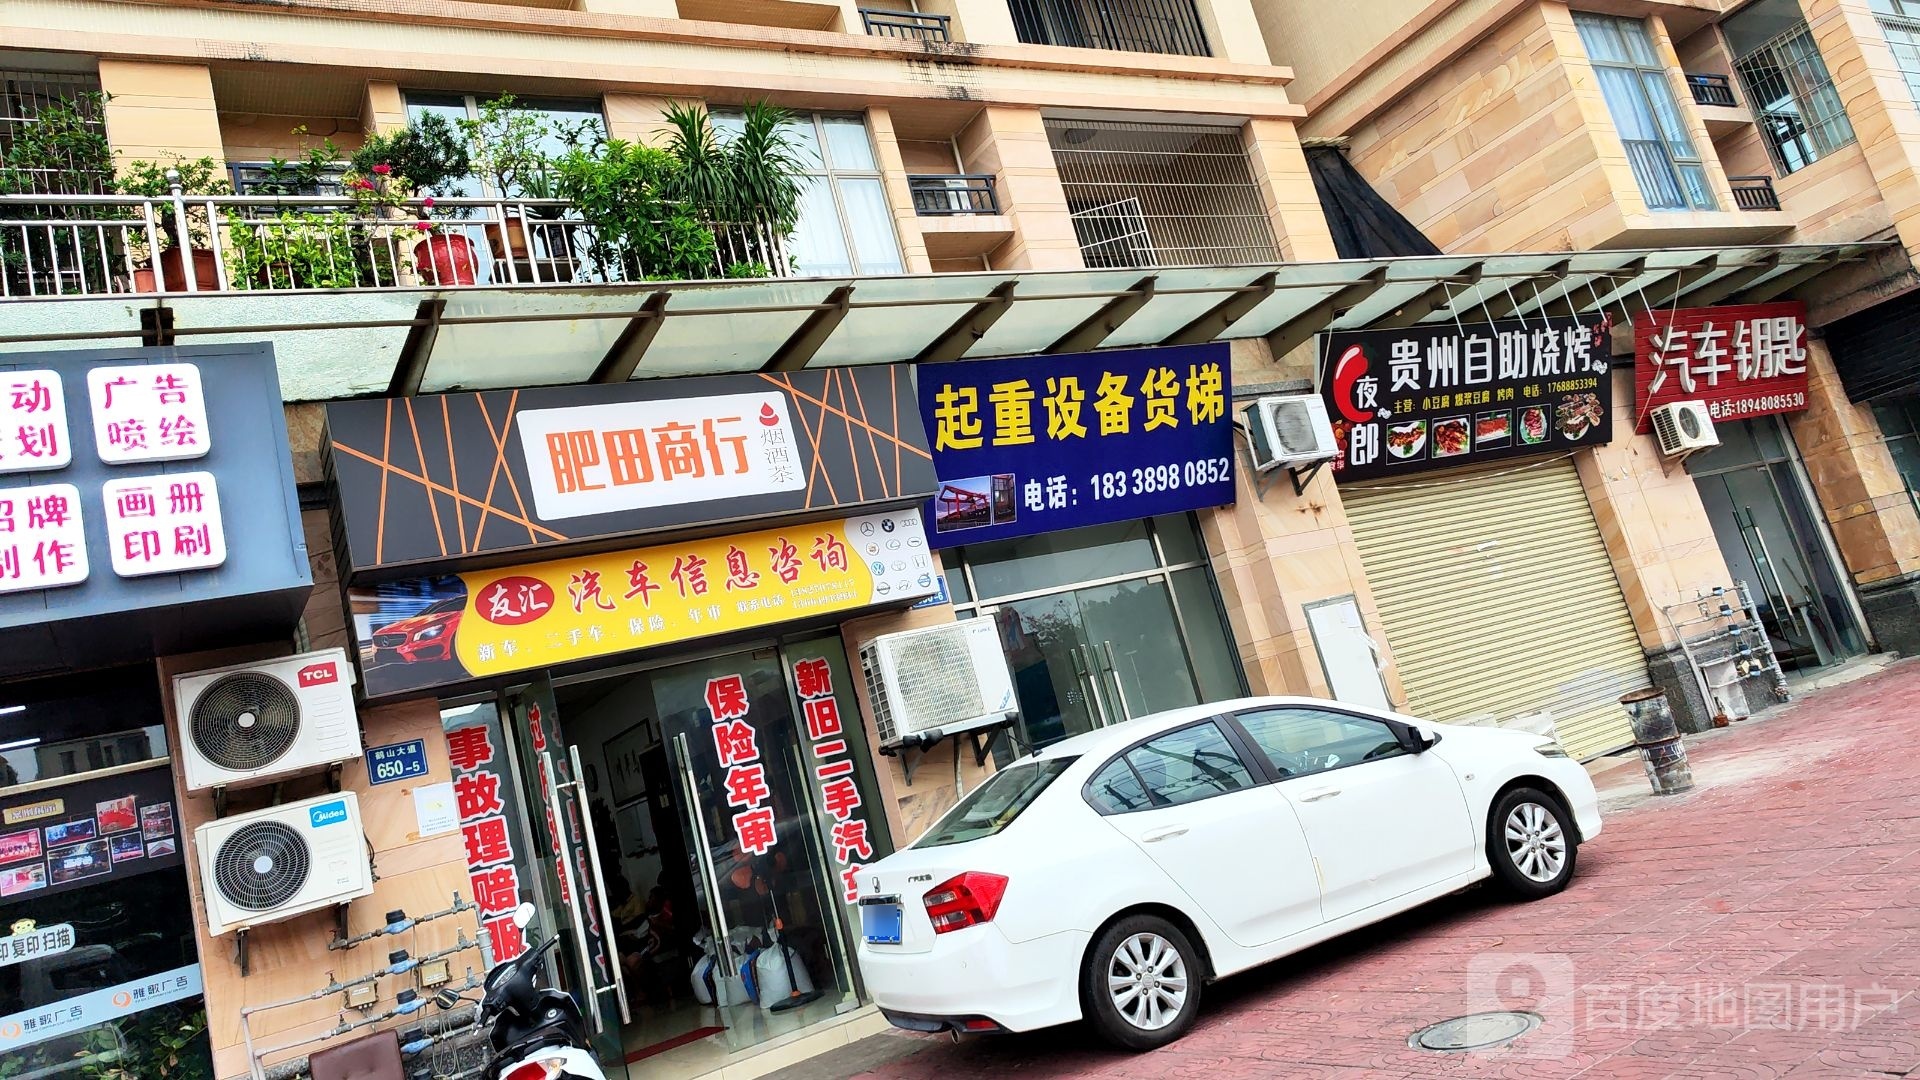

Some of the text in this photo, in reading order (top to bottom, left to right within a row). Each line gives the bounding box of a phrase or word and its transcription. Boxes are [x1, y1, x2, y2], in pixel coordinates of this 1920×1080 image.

[1388, 324, 1592, 392] 贵州自助烧烤
[1648, 316, 1807, 394] 汽车钥匙
[104, 374, 189, 409] 广告
[935, 363, 1225, 452] 起重设备货梯
[1422, 394, 1450, 411] 小豆腐
[1497, 387, 1514, 402] 烤肉
[1547, 377, 1598, 394] 17688853394
[107, 414, 198, 451] 喷绘
[545, 416, 749, 493] 肥田商行
[759, 427, 793, 486] 烟酒茶
[1090, 472, 1127, 501] 183
[1132, 464, 1180, 496] 3898
[1184, 457, 1230, 487] 0852
[116, 482, 205, 518] 画册
[124, 522, 211, 561] 印刷
[567, 533, 850, 613] 汽车信息咨询
[487, 583, 548, 621] 友汇
[303, 668, 333, 681] TCL
[704, 673, 777, 856] 保险年审
[312, 809, 345, 823] Midea
[12, 935, 40, 959] 复印
[42, 927, 71, 951] 扫描
[132, 975, 188, 999] 雅歌广告
[23, 1005, 83, 1030] 雅歌广告
